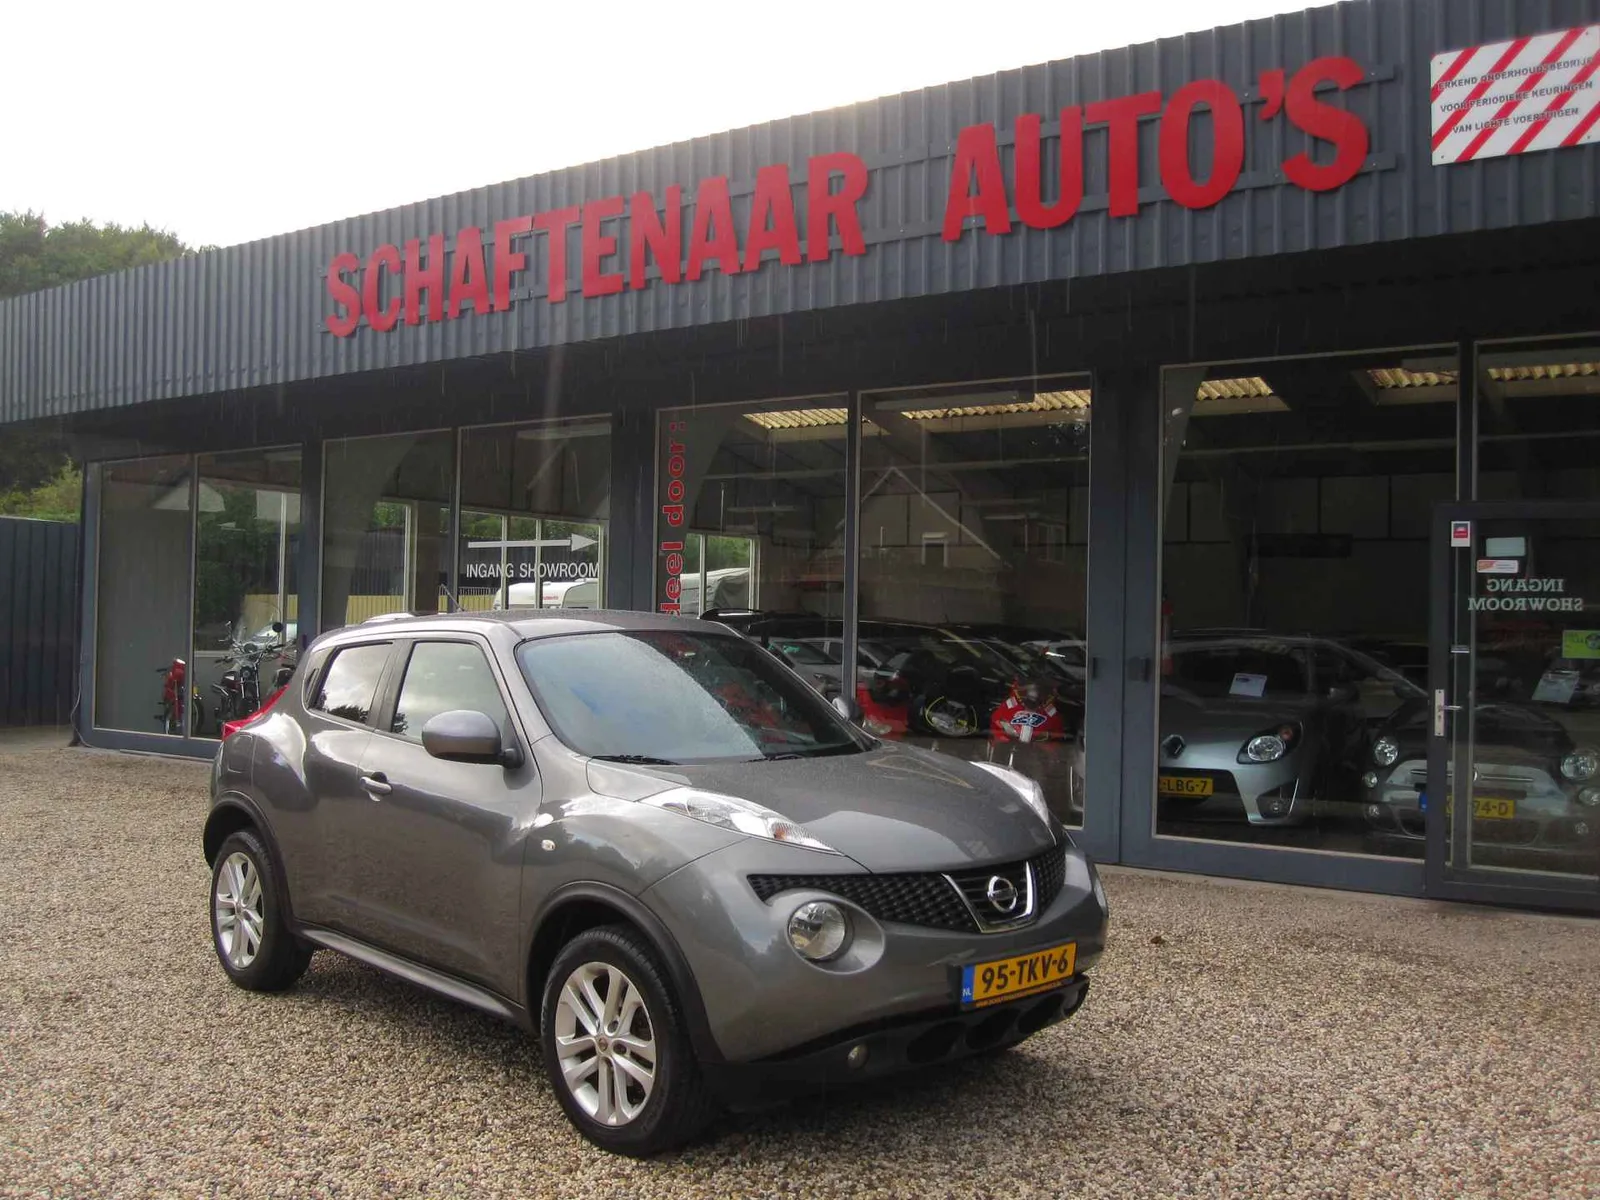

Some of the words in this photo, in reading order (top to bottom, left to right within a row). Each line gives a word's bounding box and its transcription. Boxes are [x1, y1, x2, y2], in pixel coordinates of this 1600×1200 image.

[1438, 76, 1478, 90] ERKEND
[1480, 57, 1594, 83] ONDERHOUDSBEDRIJF
[1440, 102, 1466, 113] VOOR
[1466, 91, 1529, 108] PERIODIEKE
[1531, 81, 1593, 98] KEURINGEN
[1452, 124, 1472, 134] VAN
[1475, 118, 1510, 131] LICHTE
[1513, 107, 1579, 124] VOERTUIGEN
[325, 151, 869, 338] SCHAFTENAAR
[941, 56, 1370, 243] AUTO'S
[466, 563, 514, 579] INGANG
[519, 562, 600, 579] SHOWROOM
[1158, 778, 1208, 793] -LBG-7
[981, 949, 1069, 993] 95-TKV-6
[962, 988, 972, 997] NL
